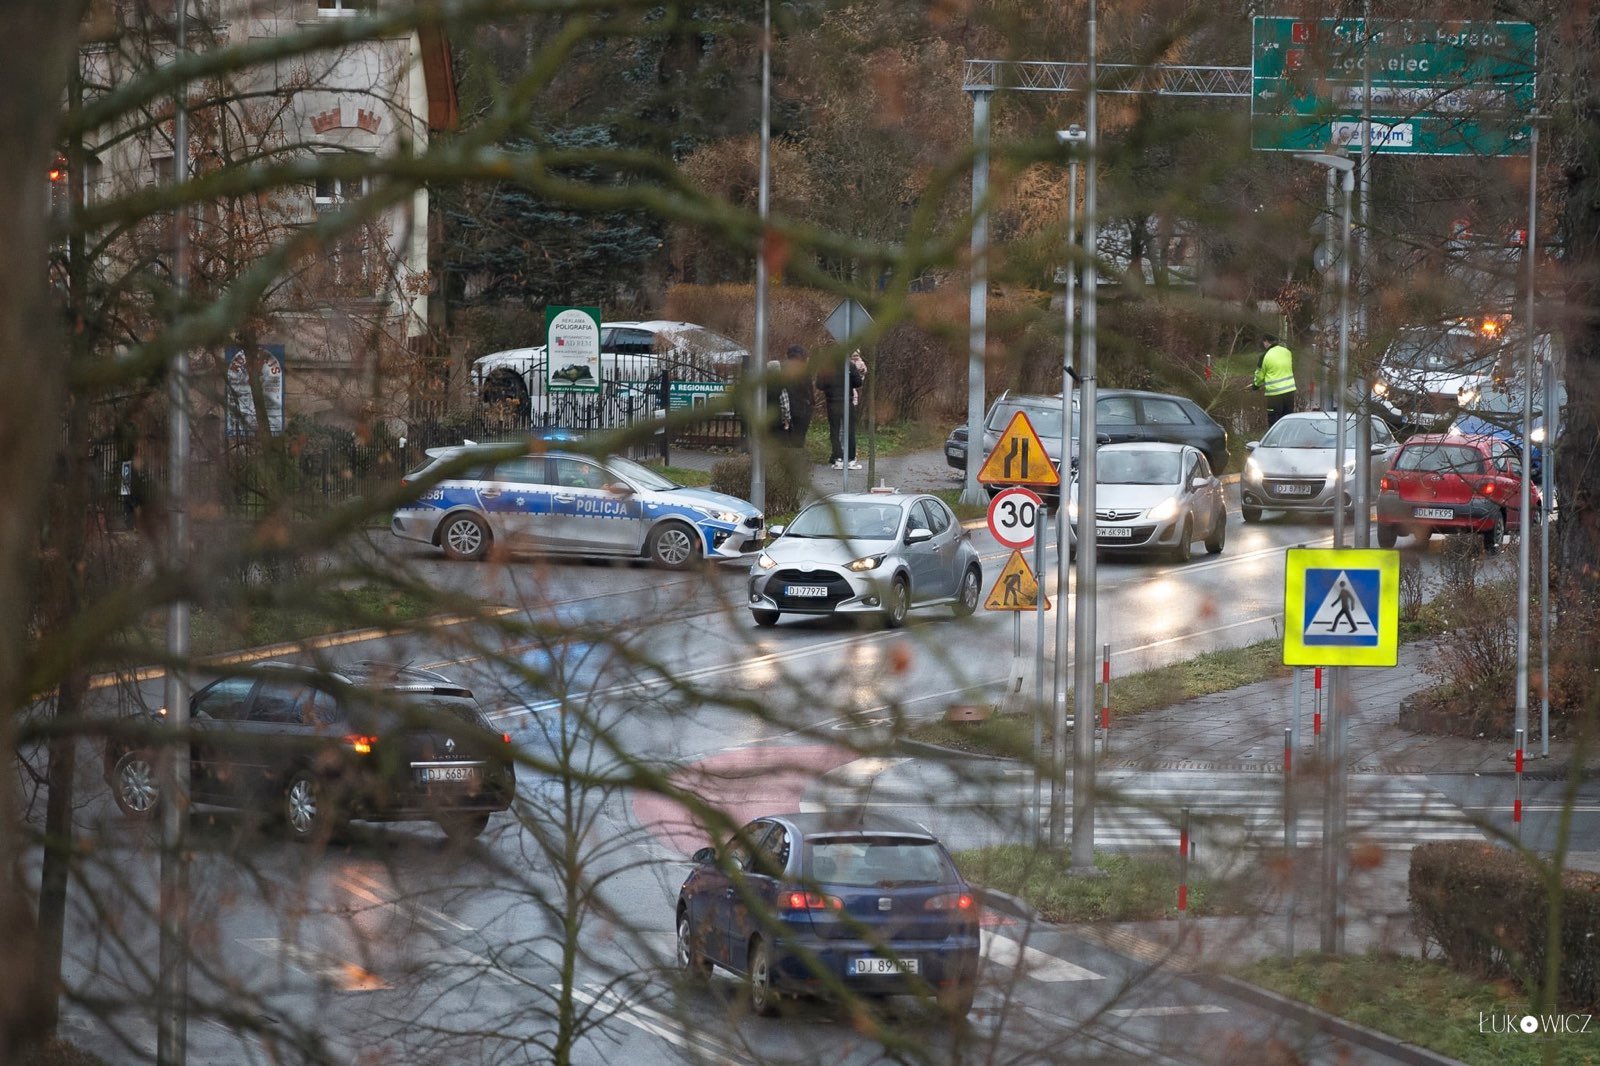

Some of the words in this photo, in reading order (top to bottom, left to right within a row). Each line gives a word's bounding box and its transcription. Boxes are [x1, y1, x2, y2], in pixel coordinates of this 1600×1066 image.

[678, 384, 724, 392] REGIONALNA
[576, 500, 627, 515] POLICJA
[1001, 501, 1035, 528] 30
[789, 587, 799, 595] DJ
[801, 587, 826, 596] 7797E
[429, 769, 441, 779] DJ
[858, 961, 872, 972] DJ
